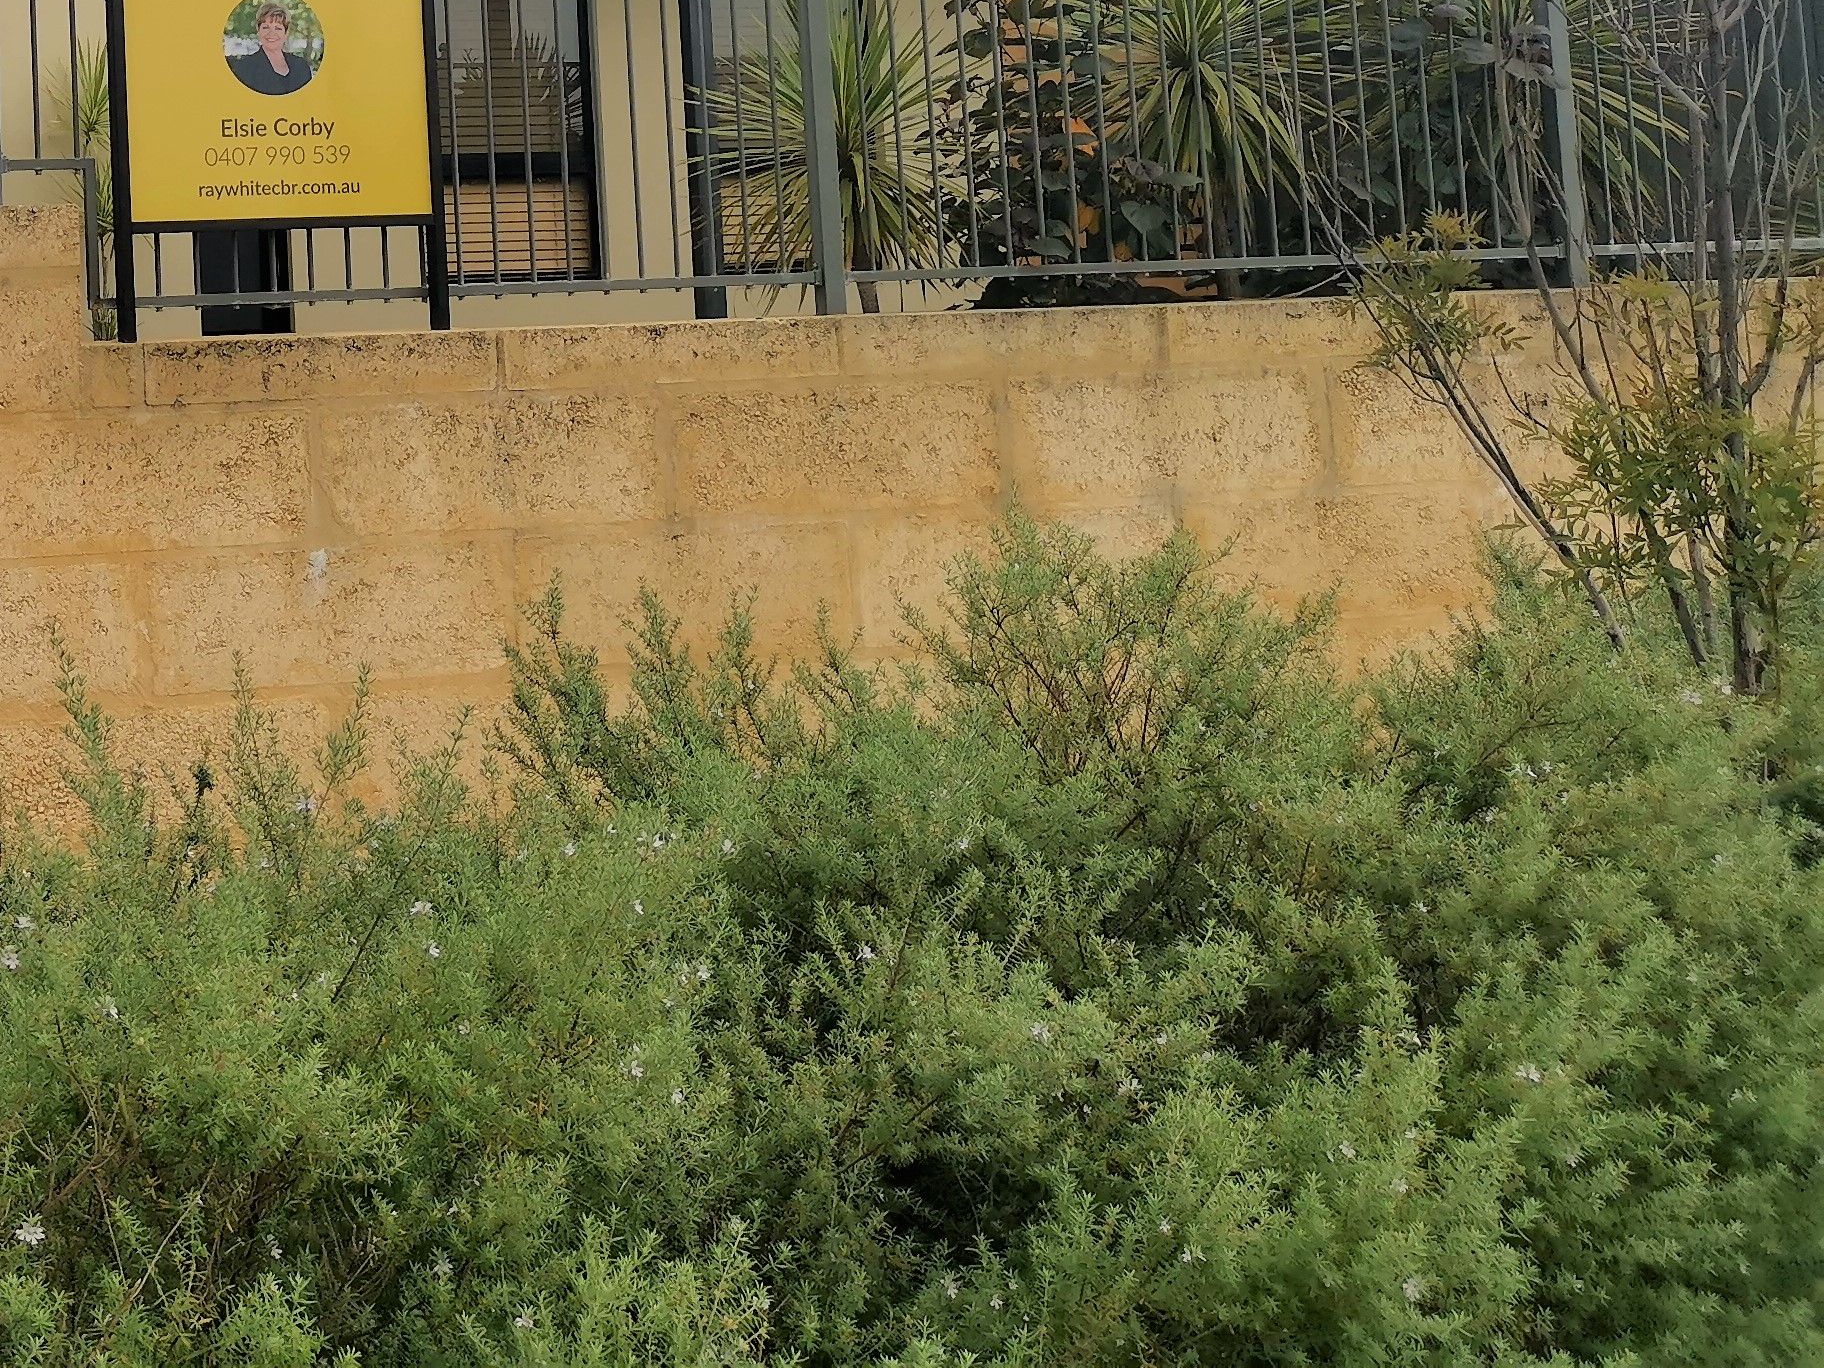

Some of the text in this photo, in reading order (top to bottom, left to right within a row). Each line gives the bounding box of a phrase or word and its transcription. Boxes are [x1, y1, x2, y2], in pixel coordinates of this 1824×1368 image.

[220, 117, 335, 139] Elsie Corby
[204, 144, 351, 166] 0407 990 539
[198, 179, 361, 200] raywhitecbr.com.au
